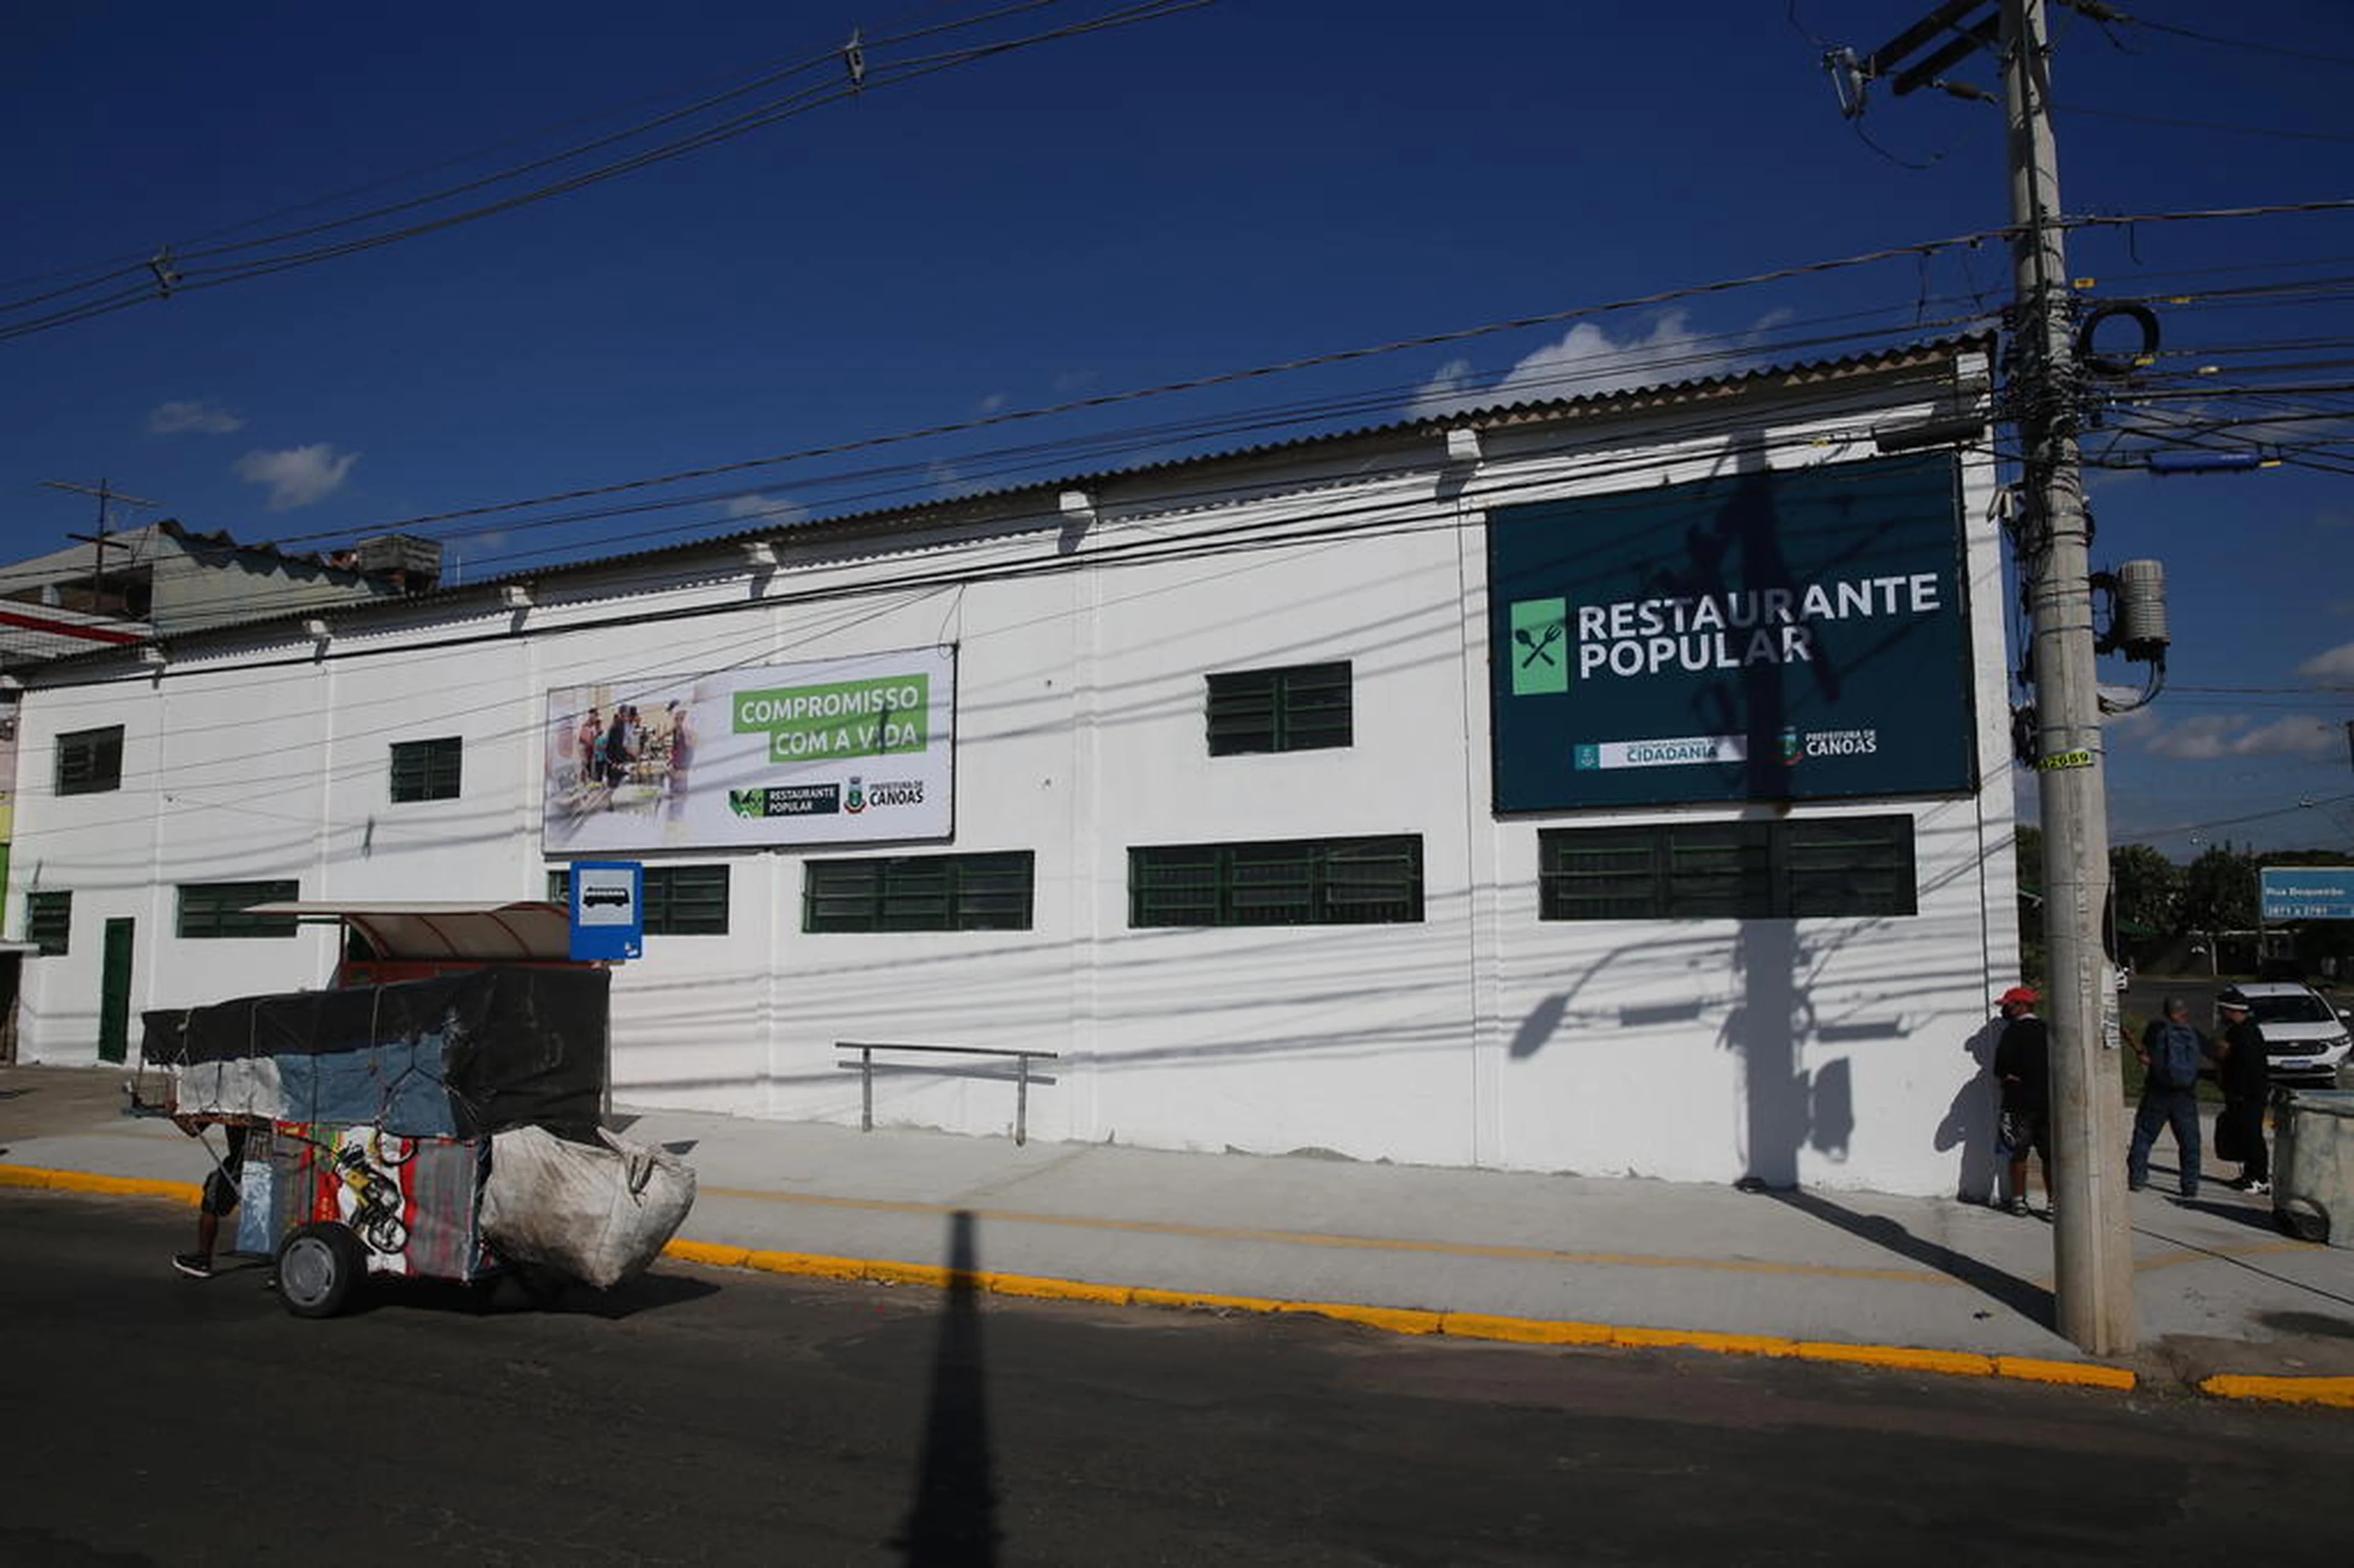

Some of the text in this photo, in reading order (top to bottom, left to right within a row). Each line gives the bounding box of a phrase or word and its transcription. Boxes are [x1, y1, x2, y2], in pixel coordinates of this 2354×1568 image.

[1579, 573, 1941, 641] RESTAURANTE
[1580, 626, 1812, 679] POPULAR
[741, 686, 918, 723] COMPROMISSO
[776, 722, 918, 755] COM A VIDA
[1806, 737, 1877, 756] CANOAS
[1626, 746, 1718, 763] CIDADANIA
[769, 786, 836, 799] RESTAURANTE
[869, 789, 924, 807] CANOAS
[769, 801, 813, 813] POPULAR
